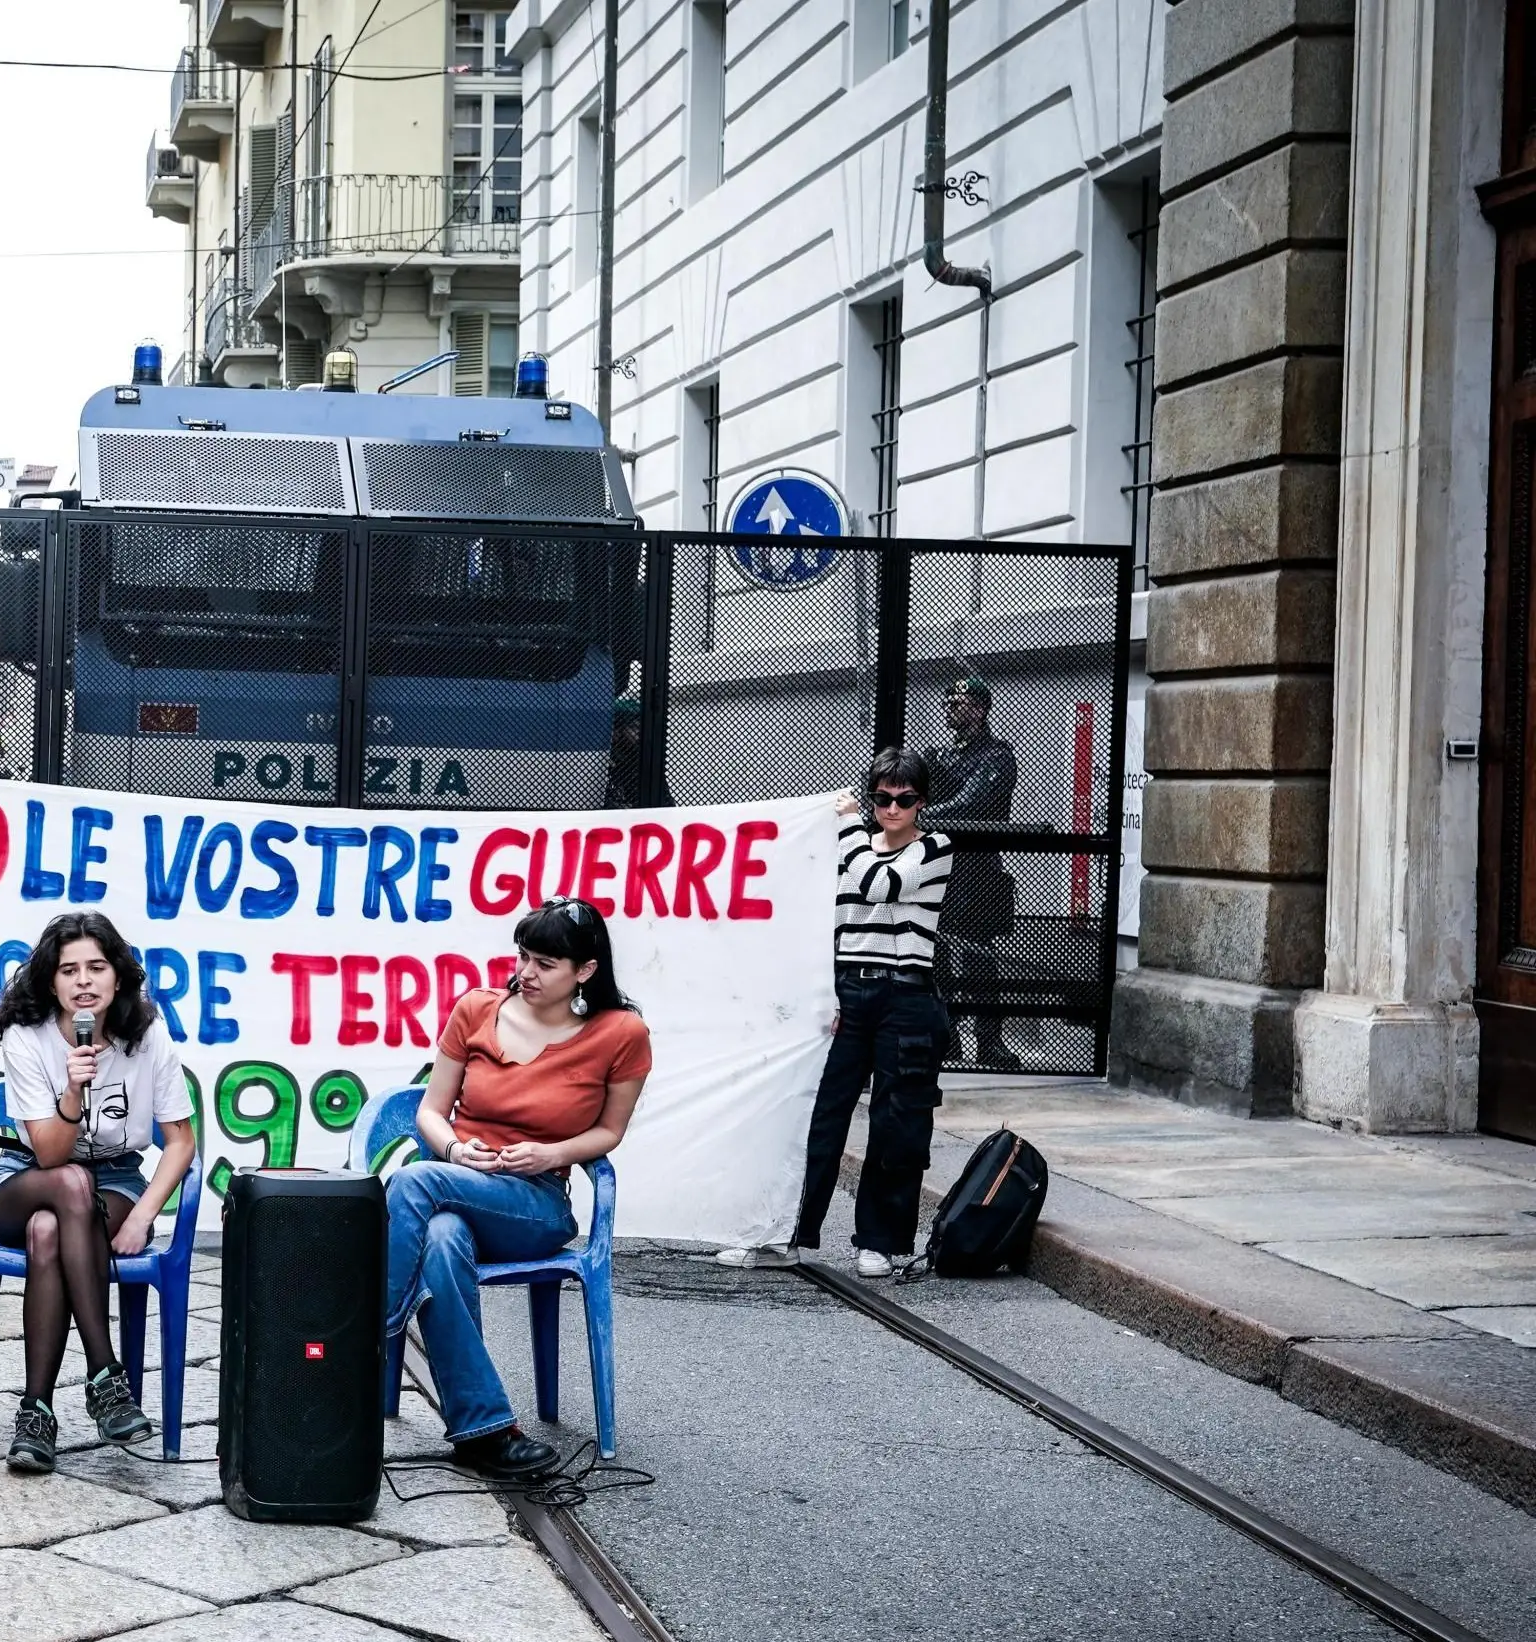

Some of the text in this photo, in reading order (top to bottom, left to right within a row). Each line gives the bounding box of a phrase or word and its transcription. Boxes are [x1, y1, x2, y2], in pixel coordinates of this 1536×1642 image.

[306, 703, 394, 735] IVO
[214, 751, 470, 798] POLZIA
[20, 800, 114, 903] LE
[143, 814, 459, 923] VOSTRE
[468, 820, 778, 922] GUERRE
